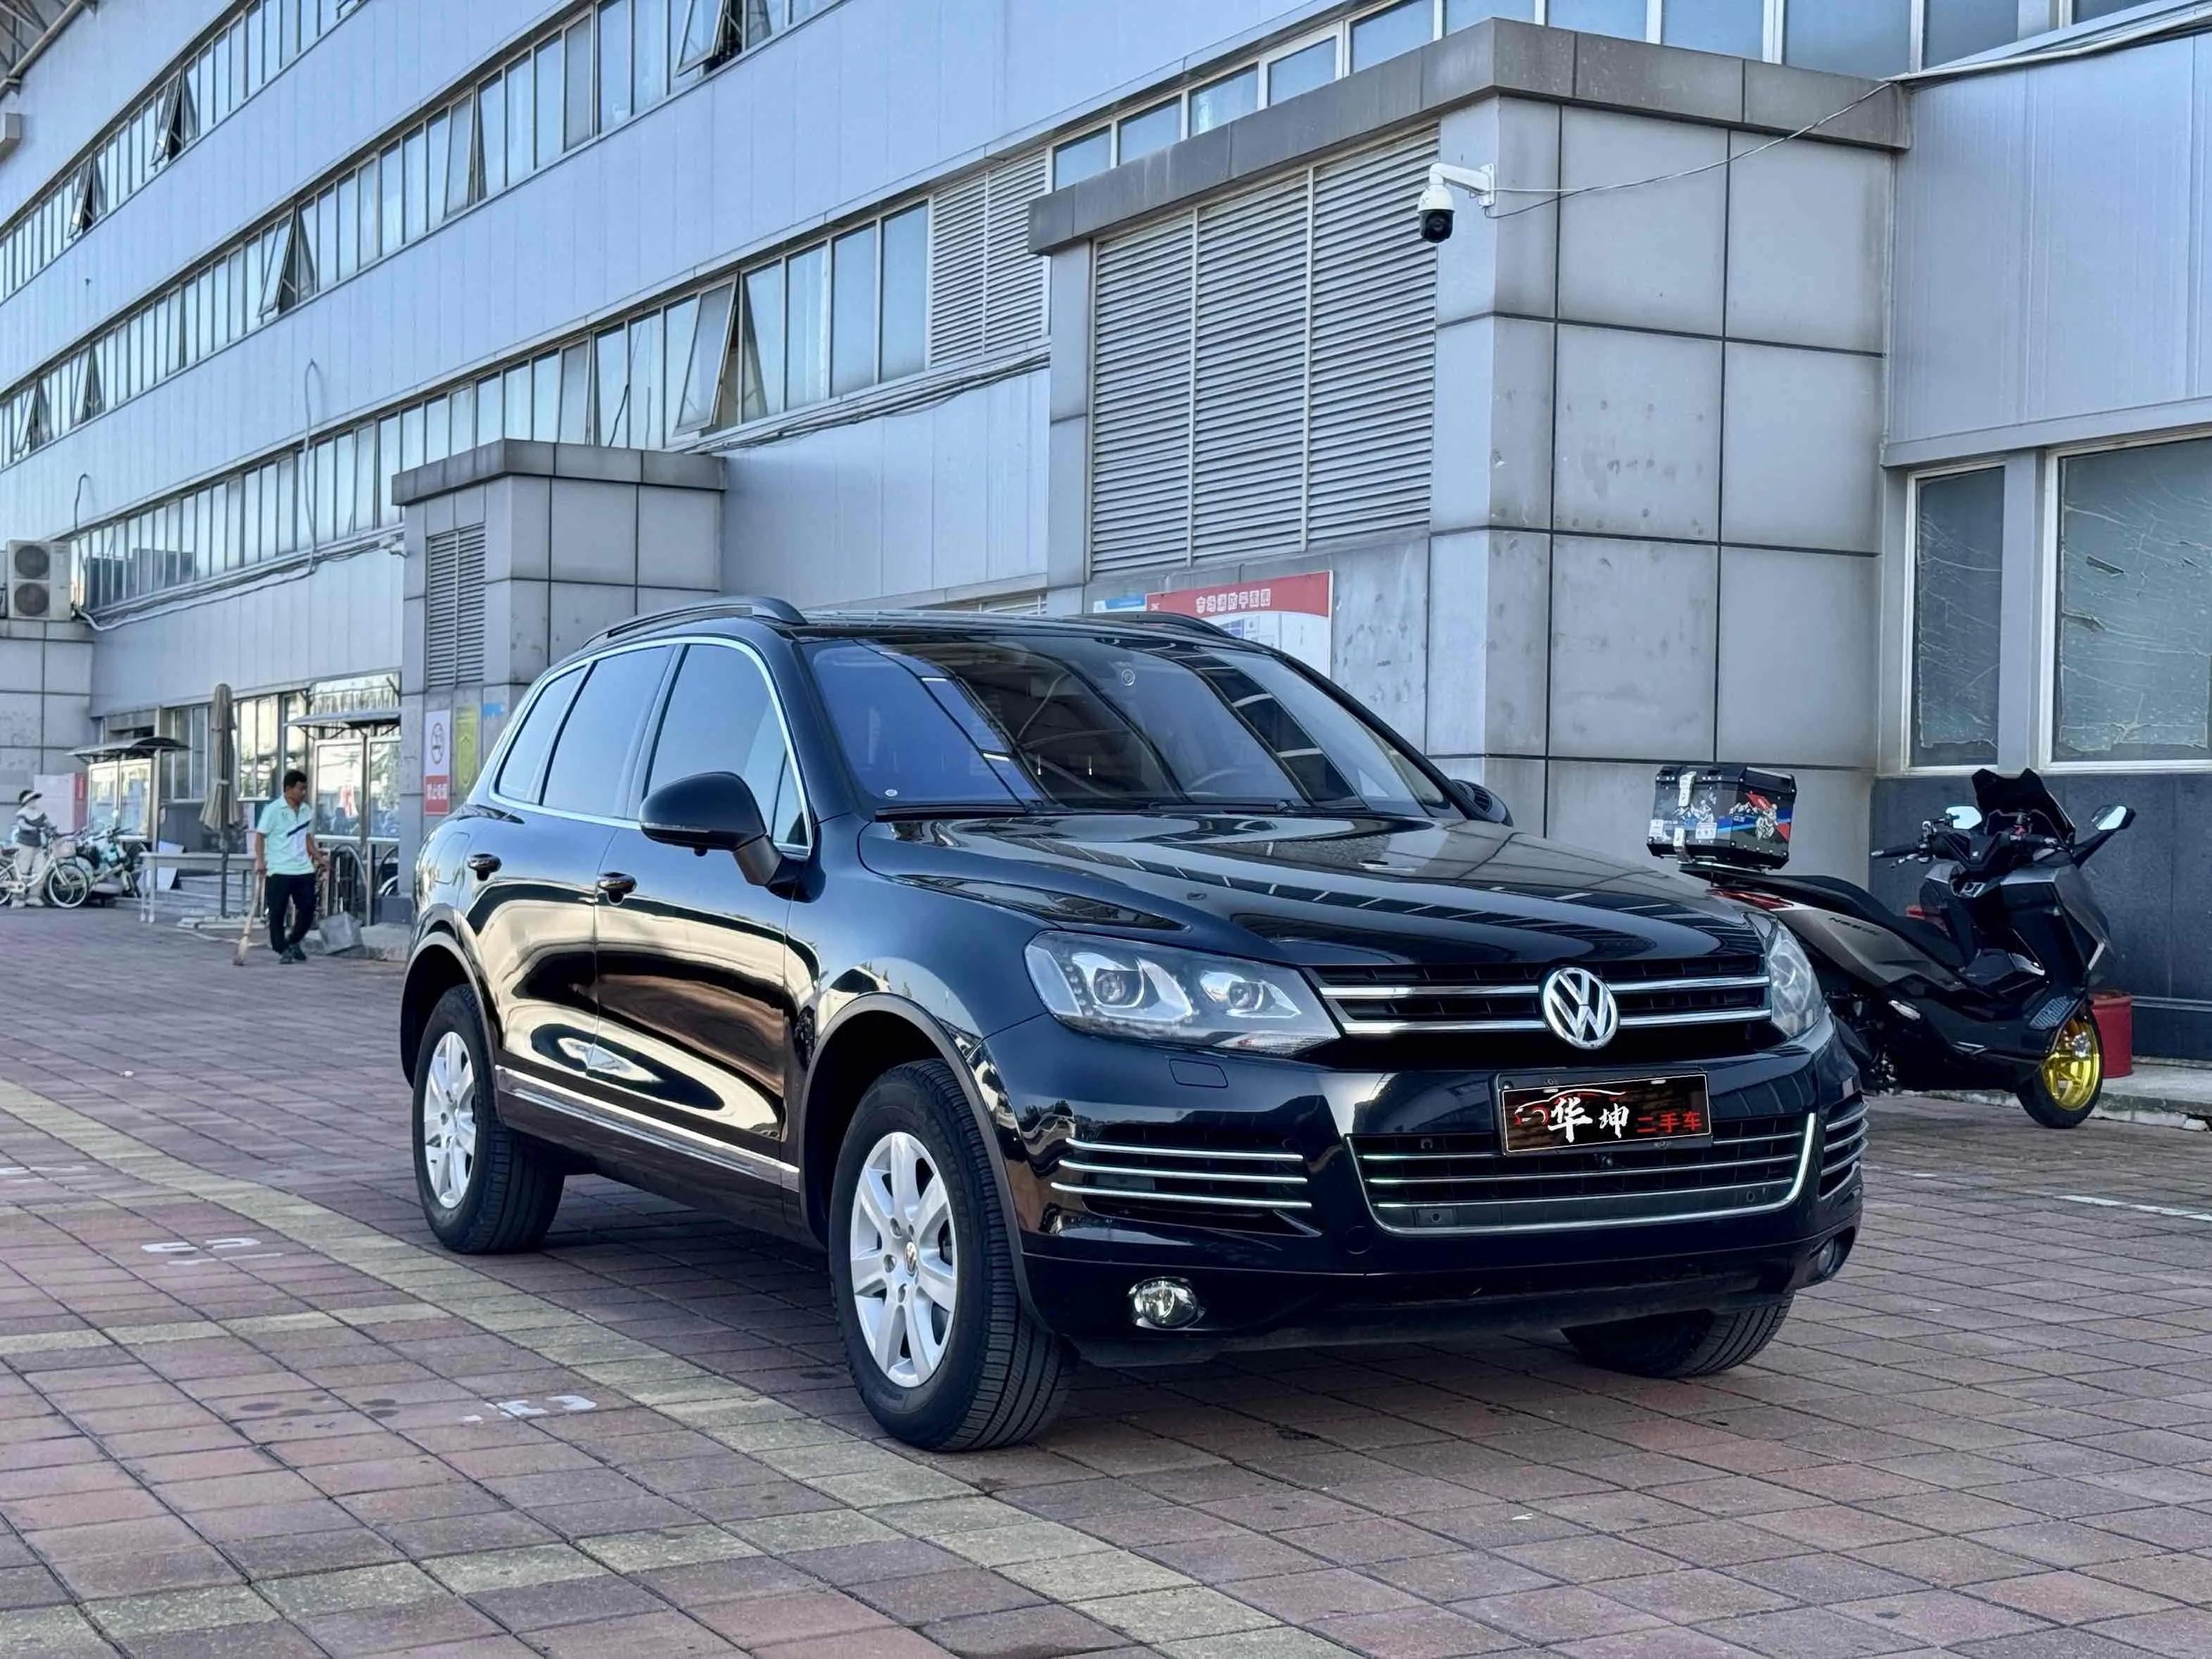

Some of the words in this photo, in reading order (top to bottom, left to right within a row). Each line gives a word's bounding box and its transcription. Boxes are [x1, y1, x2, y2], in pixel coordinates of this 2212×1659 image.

[1548, 1096, 1630, 1144] 华坤
[1637, 1110, 1702, 1134] 二手车
